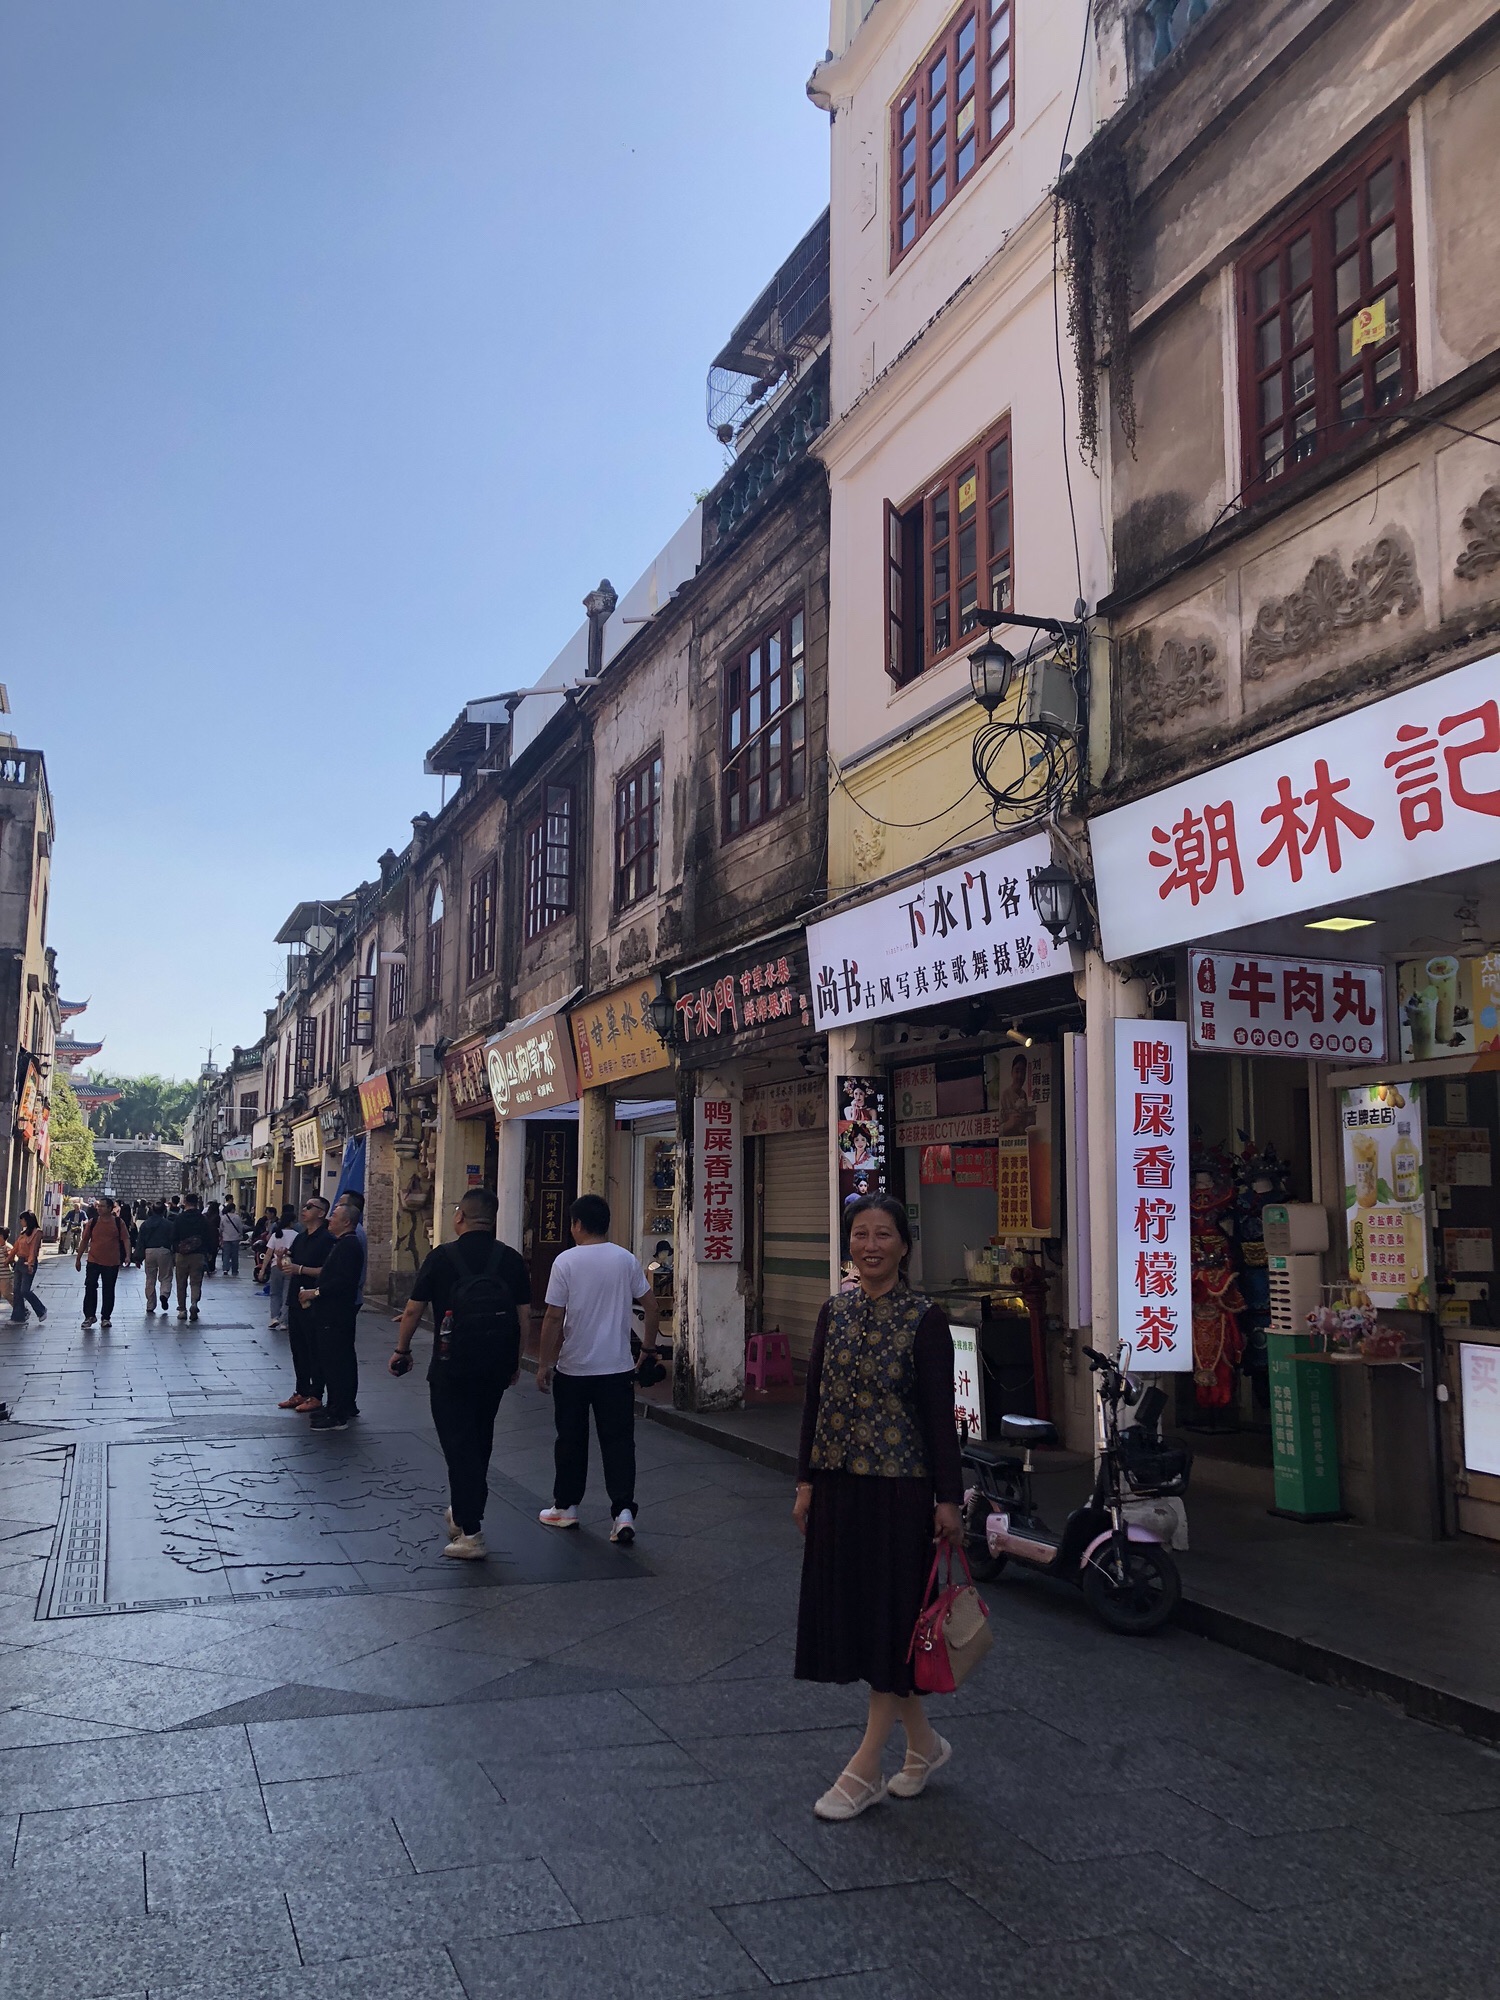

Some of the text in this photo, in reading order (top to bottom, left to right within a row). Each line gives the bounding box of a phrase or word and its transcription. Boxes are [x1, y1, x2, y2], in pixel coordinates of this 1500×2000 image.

[1149, 699, 1500, 906] 潮林記
[676, 975, 738, 1042] 下水門
[739, 956, 790, 997] 甘草水果
[743, 987, 792, 1026] 鲜榨果汁
[1229, 962, 1376, 1026] 牛肉丸
[1200, 1001, 1216, 1041] 官塘
[704, 1101, 734, 1260] 鸭屎香柠檬茶
[1132, 1040, 1178, 1352] 鸭屎香柠檬茶
